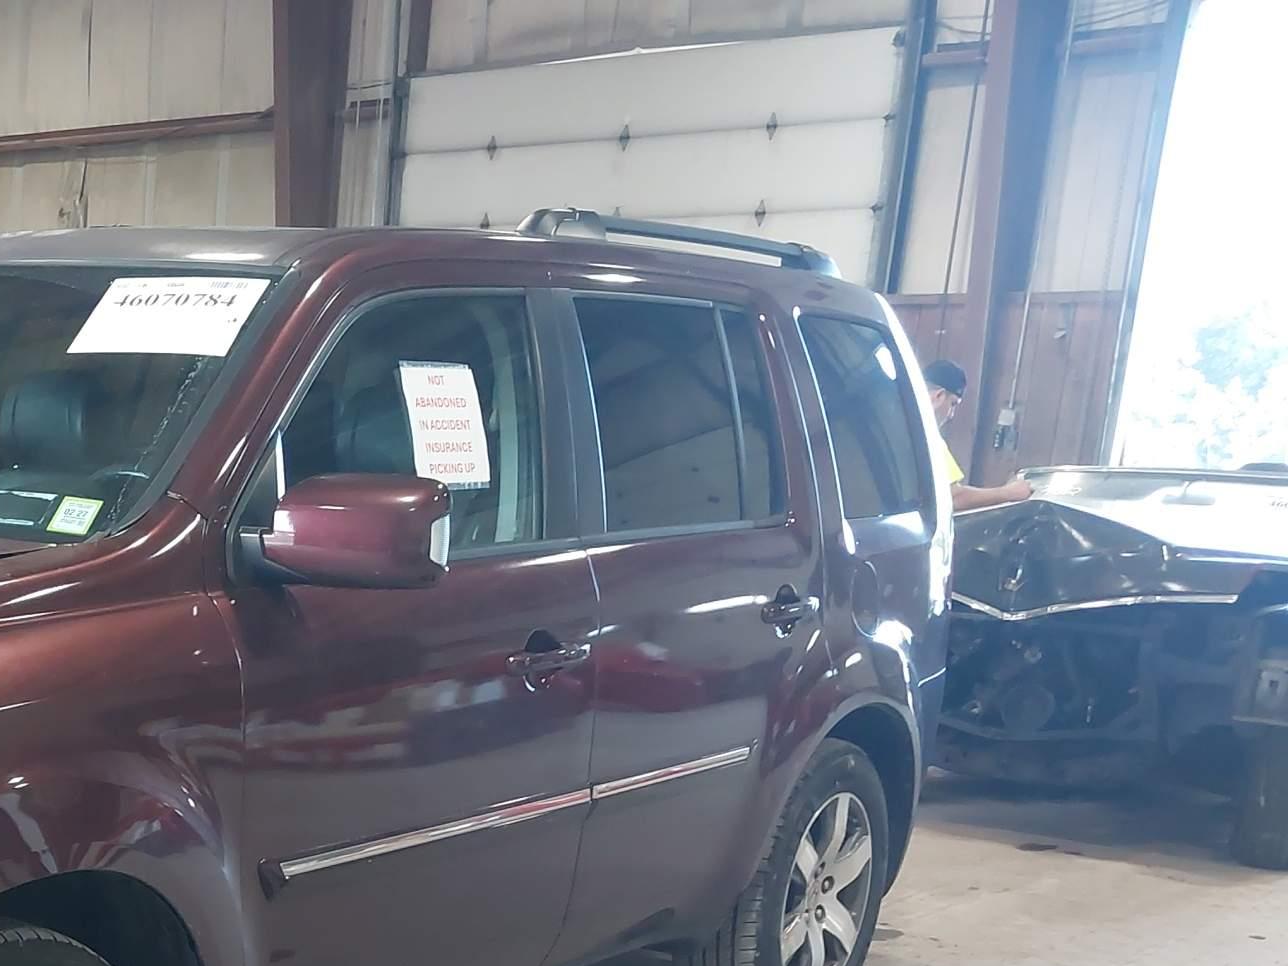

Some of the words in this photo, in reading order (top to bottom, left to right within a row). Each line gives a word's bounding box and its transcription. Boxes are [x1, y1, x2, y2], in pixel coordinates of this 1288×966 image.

[113, 293, 238, 307] 46070784
[427, 375, 444, 386] NOT
[415, 397, 467, 408] ABANDONED
[419, 420, 429, 431] IN
[430, 419, 471, 431] ACCIDENT
[425, 441, 473, 453] INSURANCE
[429, 463, 463, 475] PICKING
[464, 463, 476, 474] UP
